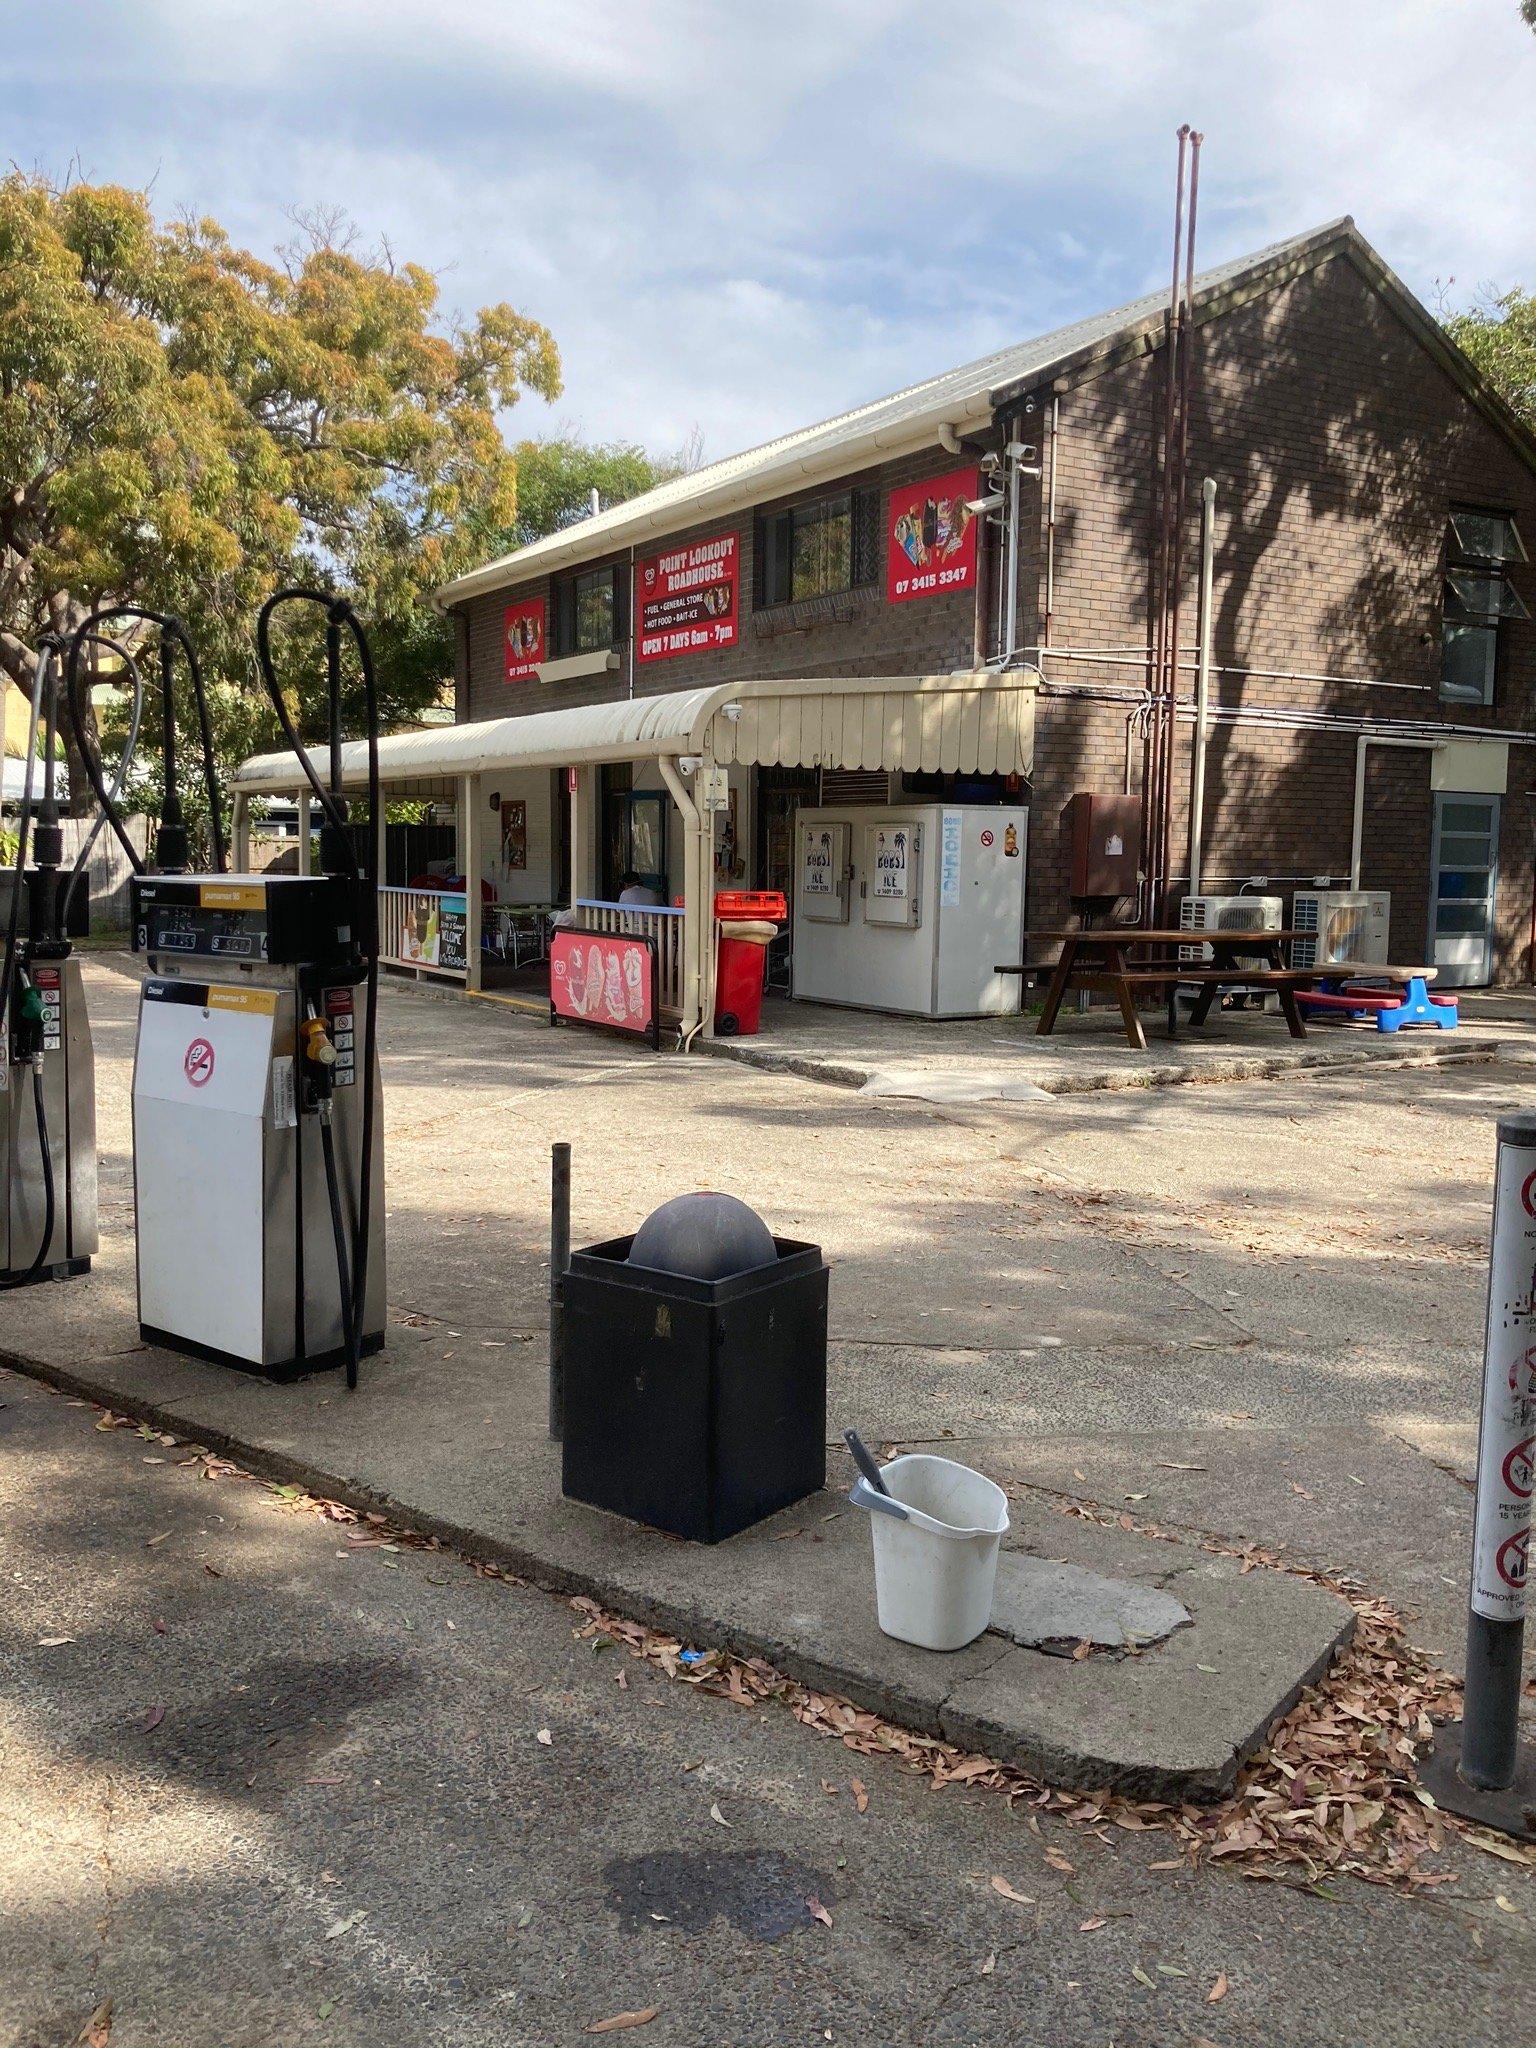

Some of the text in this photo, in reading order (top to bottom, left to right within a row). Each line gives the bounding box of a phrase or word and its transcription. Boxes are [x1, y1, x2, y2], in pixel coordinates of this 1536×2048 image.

[660, 537, 734, 575] POINT LOOKOUT
[668, 561, 724, 592] ROADHOUSE
[896, 566, 968, 594] 07 3415 3347
[647, 593, 703, 615] FUEL GENERAL STORE
[647, 619, 658, 629] HOT
[658, 615, 672, 627] FOOD
[642, 637, 662, 656] OPEN
[663, 636, 669, 651] 7
[669, 631, 690, 650] DAYS
[691, 629, 708, 646] 6am
[714, 624, 733, 644] 7pm
[811, 869, 824, 884] ICE
[883, 872, 897, 887] ICE
[139, 927, 146, 947] 3
[147, 986, 164, 996] Diesel
[1477, 1587, 1520, 1601] APPROVED
